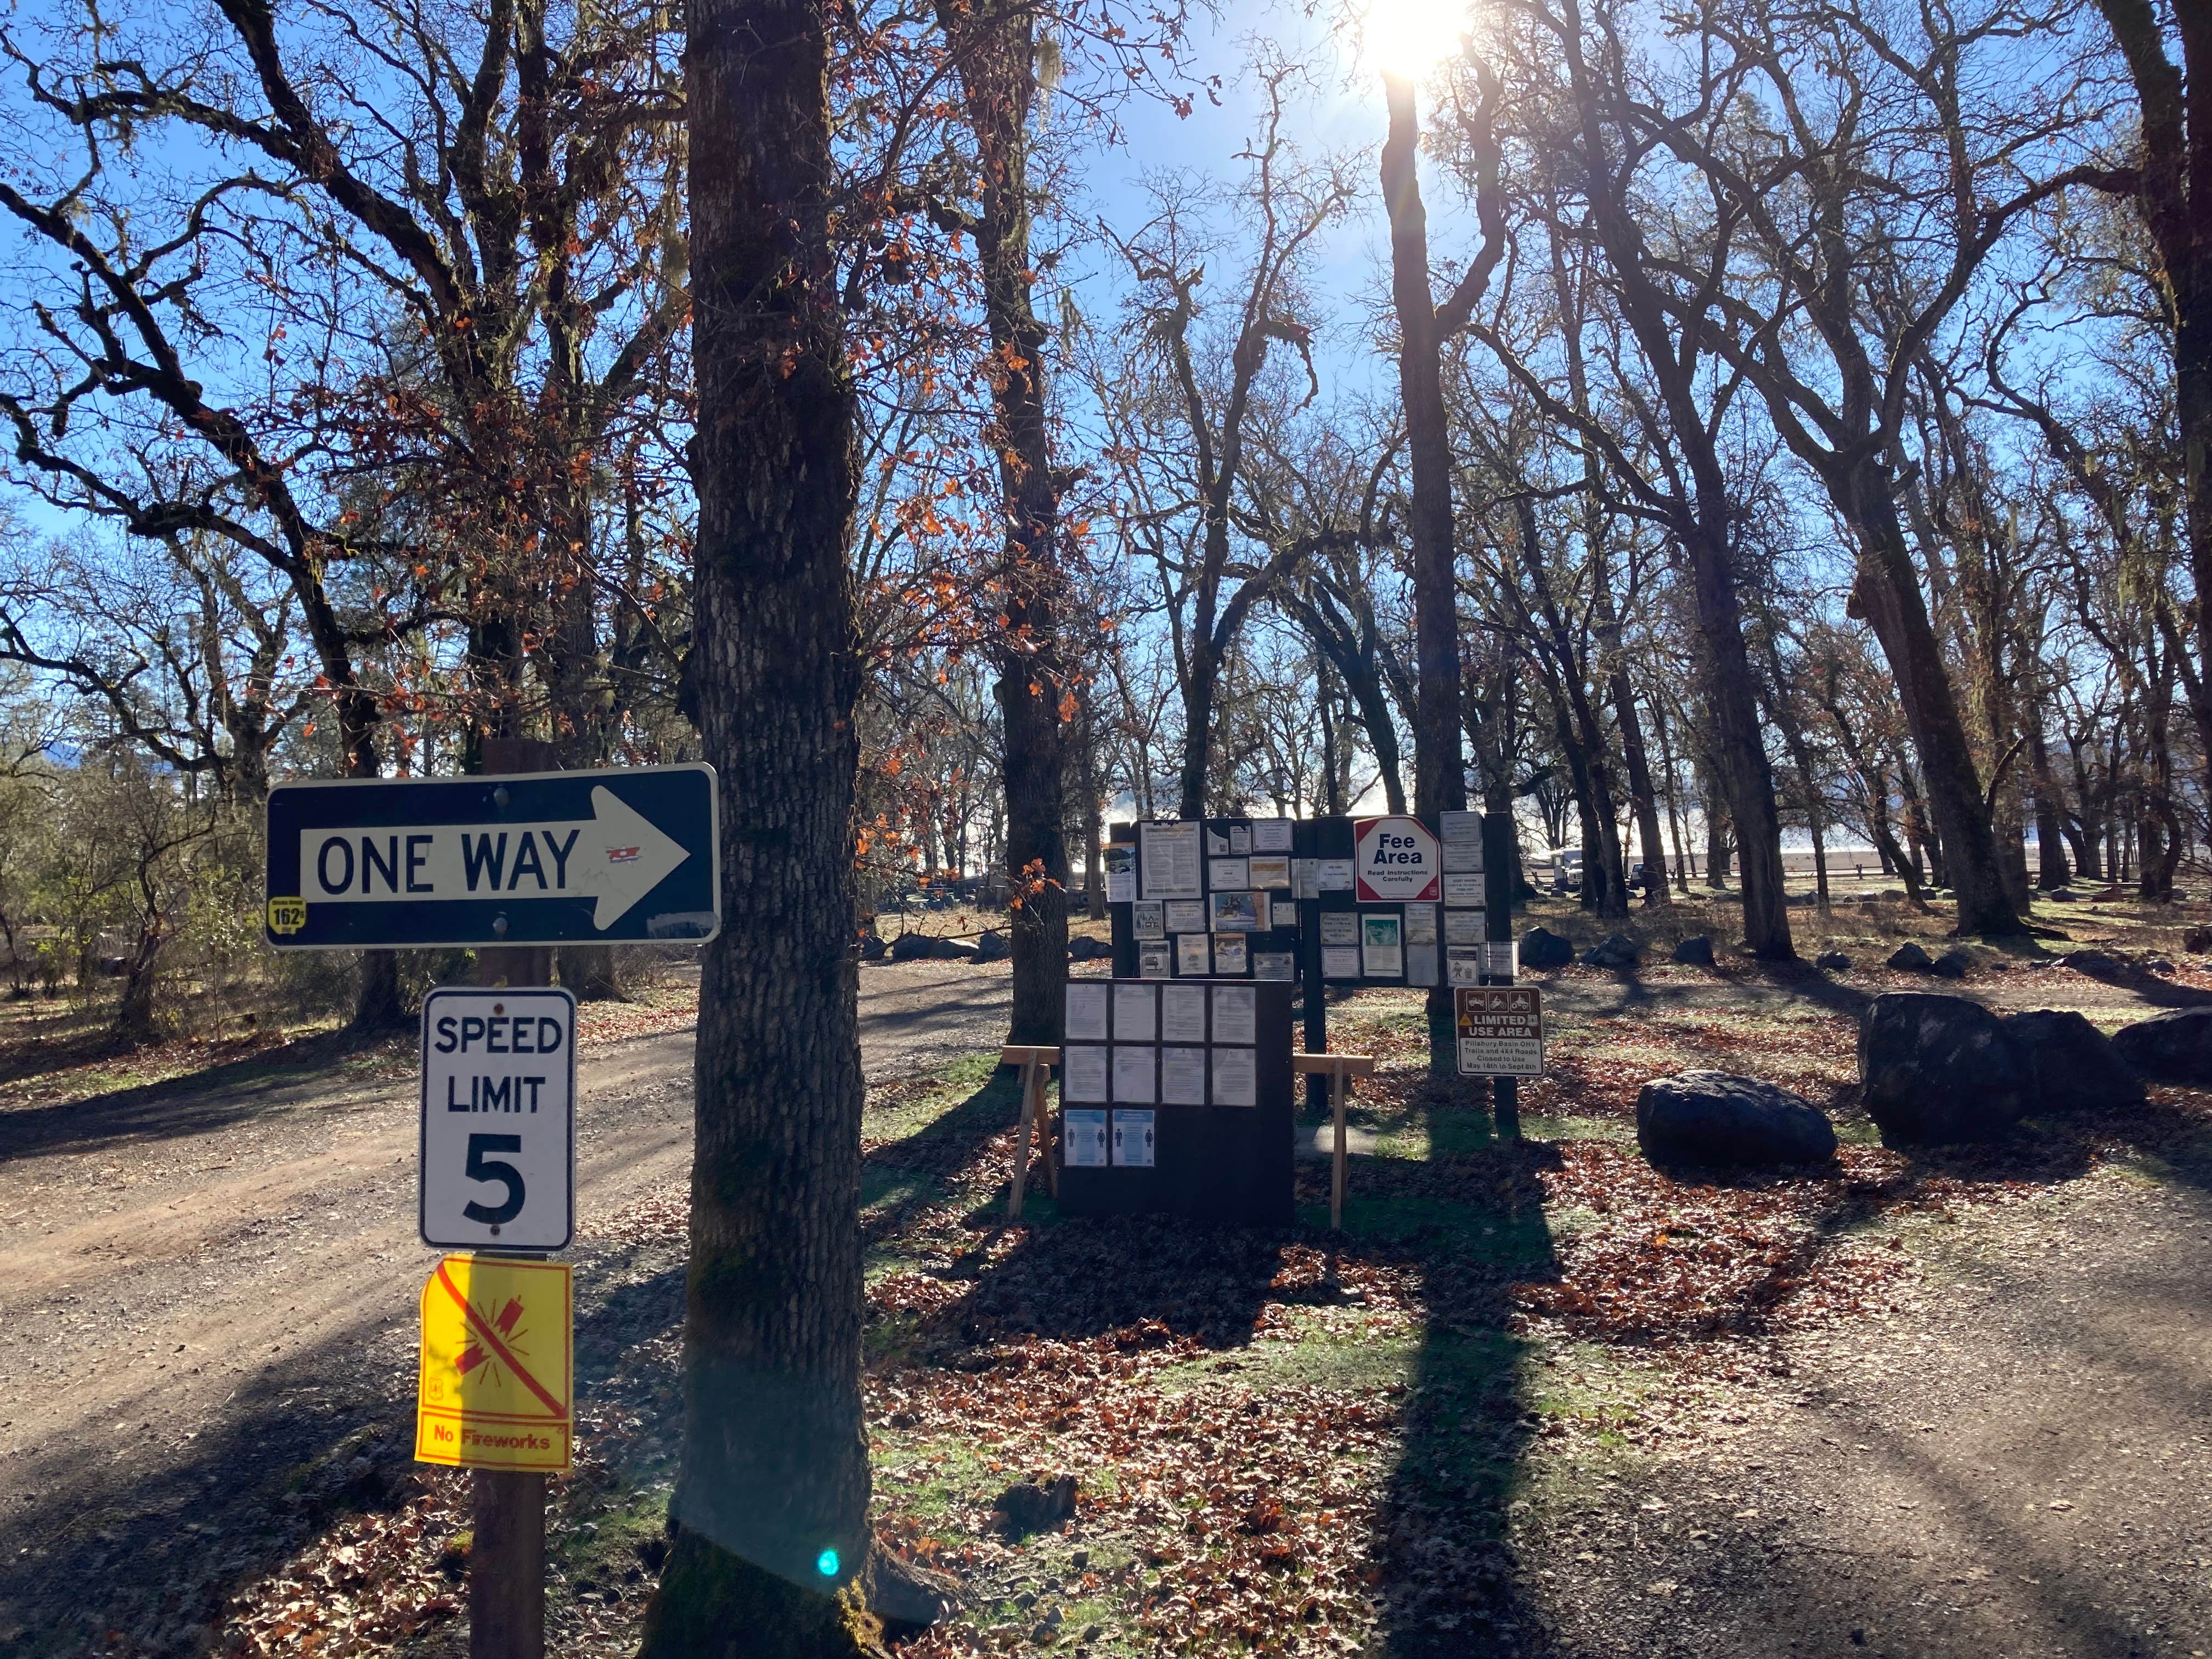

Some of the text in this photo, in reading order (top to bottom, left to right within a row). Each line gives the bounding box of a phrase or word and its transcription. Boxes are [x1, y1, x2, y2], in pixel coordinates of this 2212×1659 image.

[1380, 833, 1415, 848] Fee
[317, 829, 580, 895] ONE WAY
[1373, 849, 1422, 864] Area
[274, 908, 300, 925] 162
[1474, 1015, 1526, 1025] LIMITED
[434, 1017, 562, 1054] SPEED
[1468, 1026, 1532, 1037] USE AREA
[447, 1076, 546, 1114] LIMIT
[462, 1133, 526, 1225] 5
[434, 1424, 550, 1450] No Fireworks
